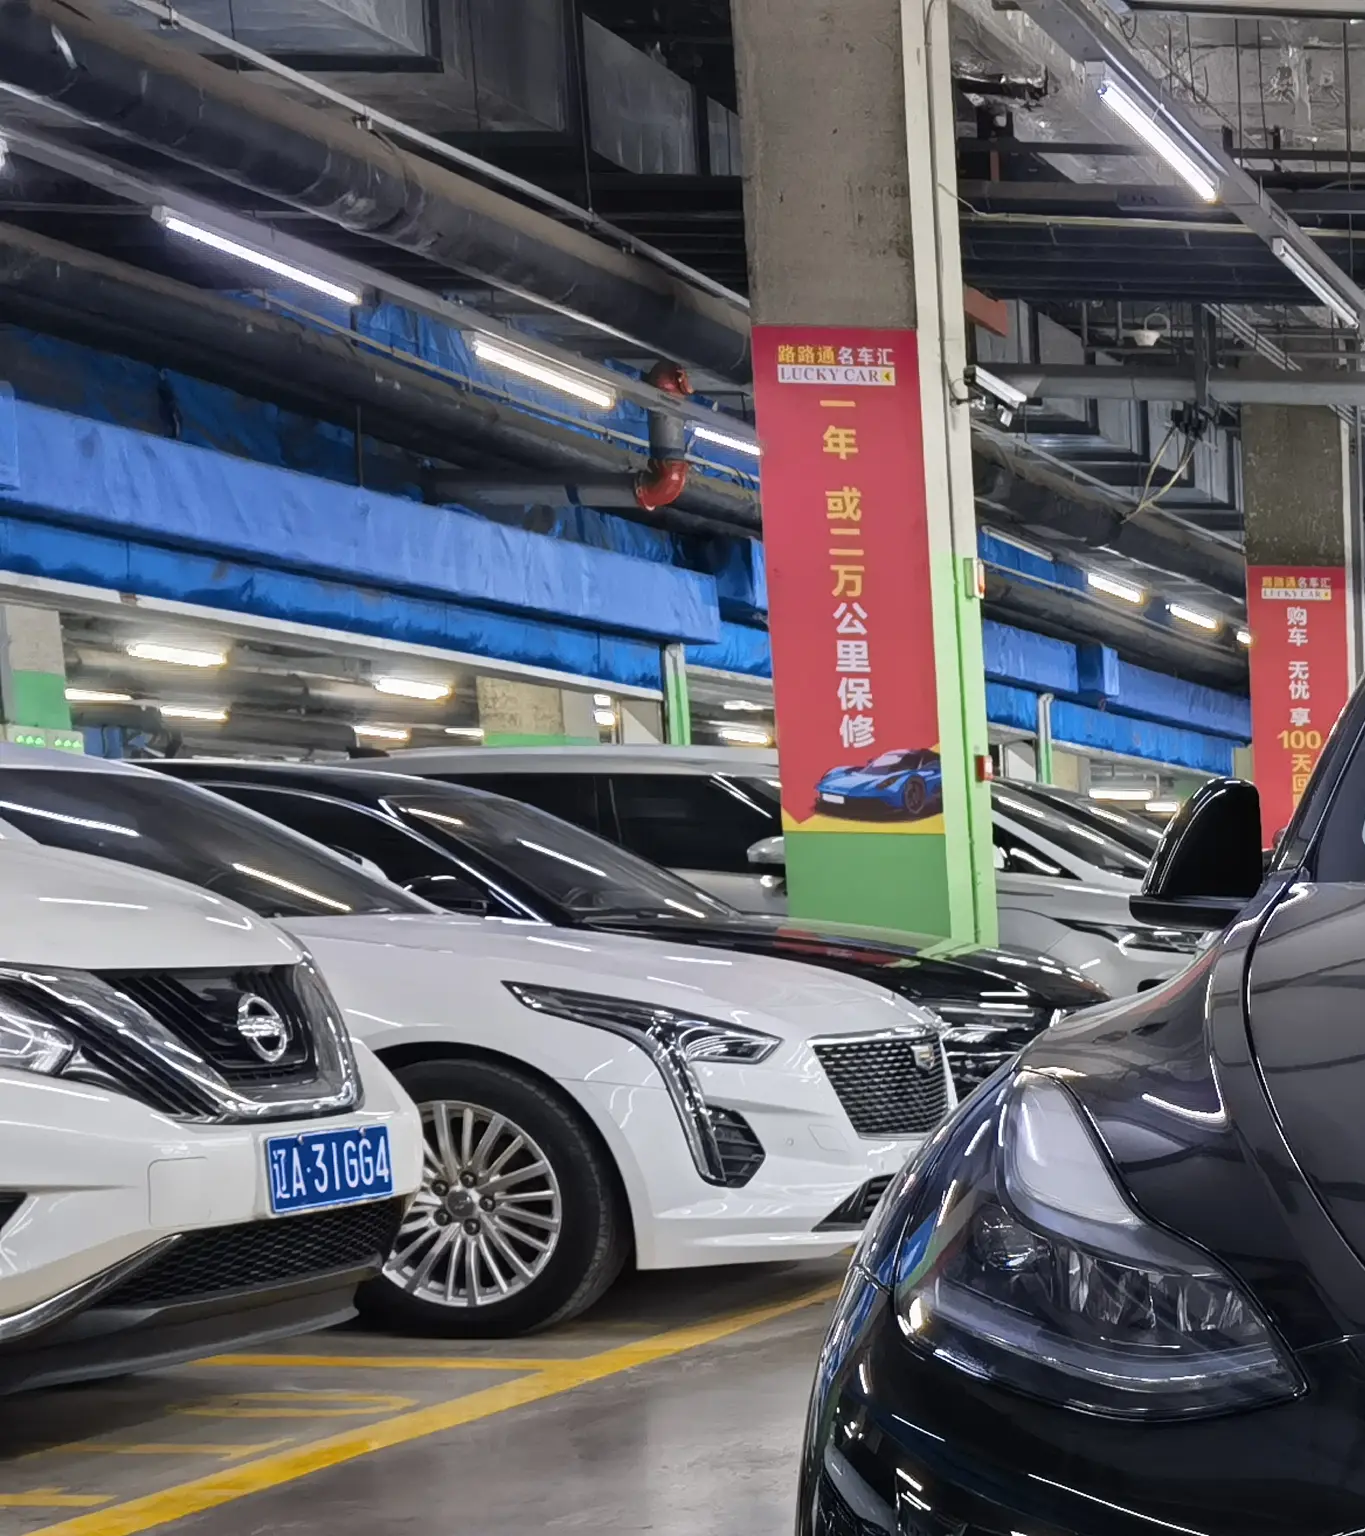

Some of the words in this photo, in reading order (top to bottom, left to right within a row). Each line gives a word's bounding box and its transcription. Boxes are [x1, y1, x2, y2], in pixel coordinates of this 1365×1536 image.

[778, 344, 895, 365] 路路通名车汇
[780, 367, 839, 381] LUCKY
[844, 368, 879, 382] CAR
[820, 399, 859, 460] 一年
[825, 486, 875, 749] 或二万公里保修
[1286, 606, 1308, 647] 购车
[1288, 661, 1310, 700] 无忧
